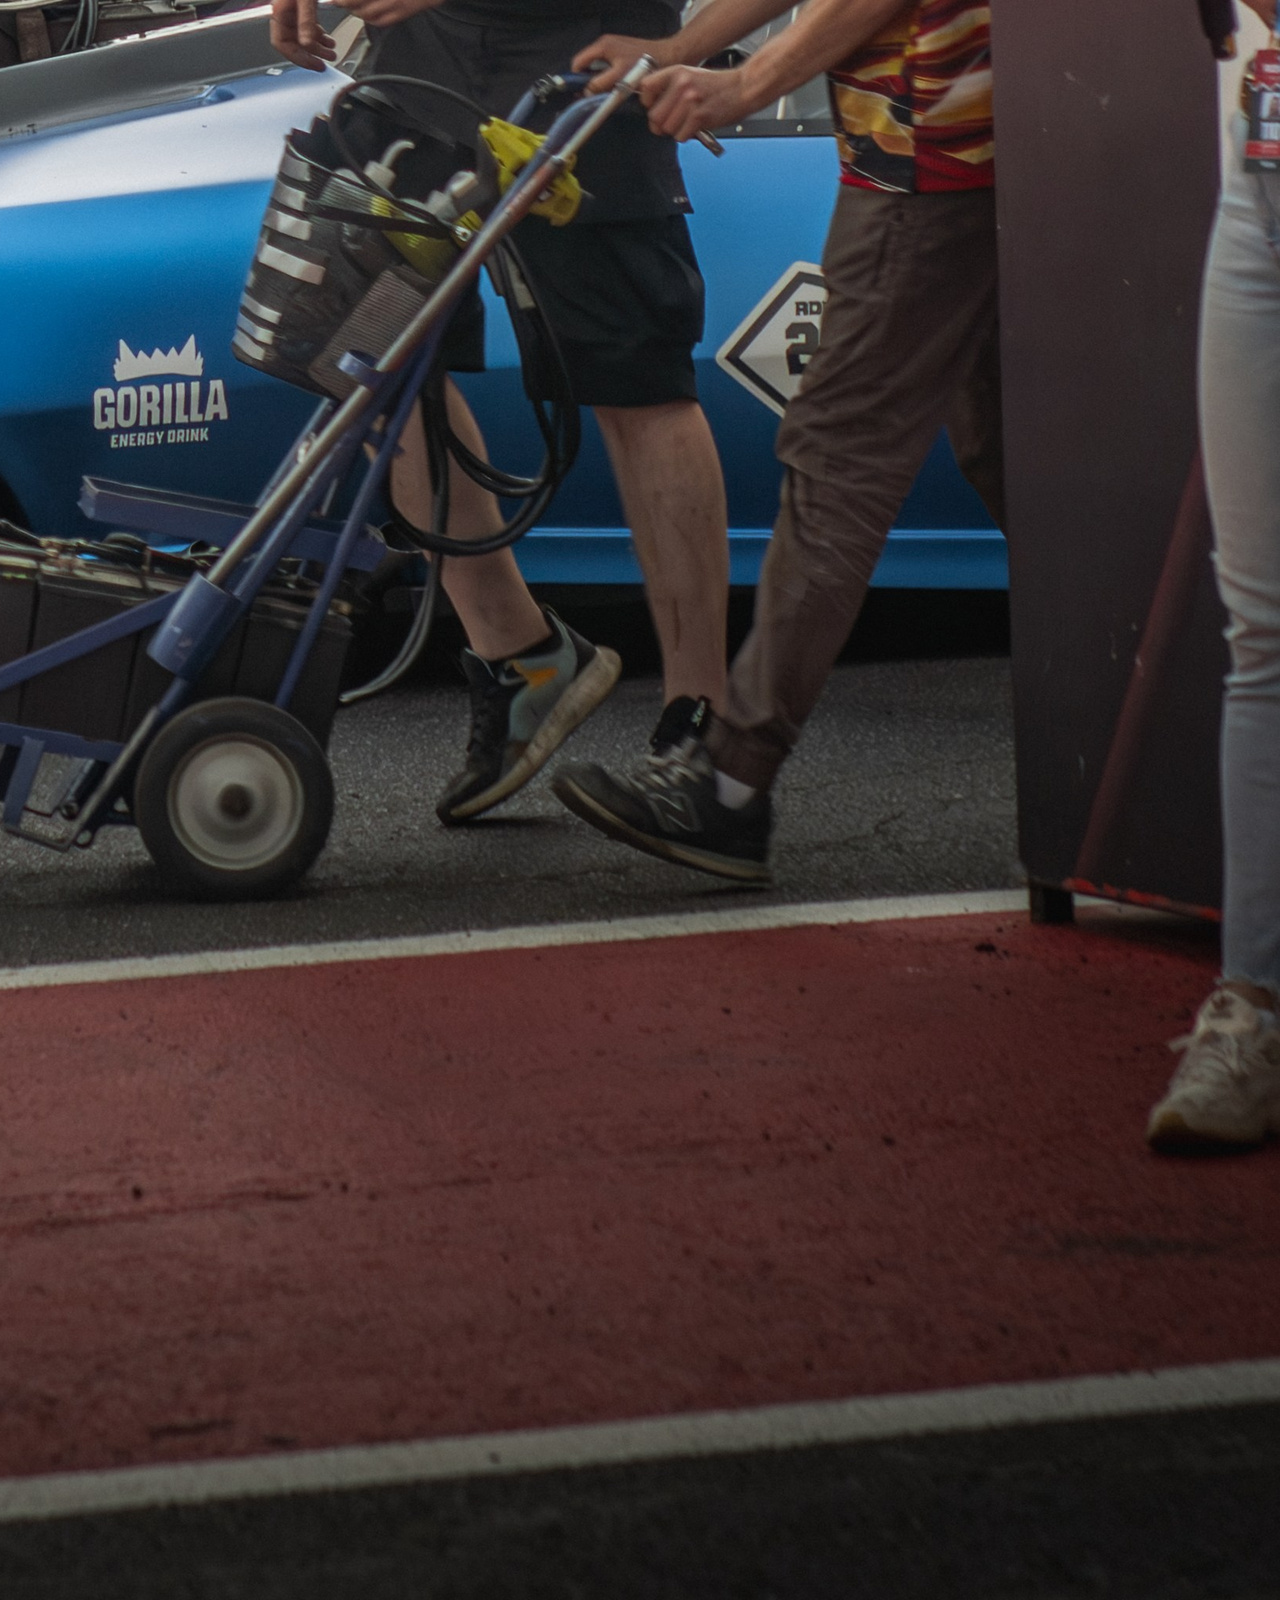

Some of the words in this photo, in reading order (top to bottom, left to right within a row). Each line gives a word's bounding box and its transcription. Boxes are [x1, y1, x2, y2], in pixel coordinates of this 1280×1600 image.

[93, 379, 228, 429] GORILLA
[110, 430, 164, 448] ENERGY
[167, 427, 209, 444] DRINK
